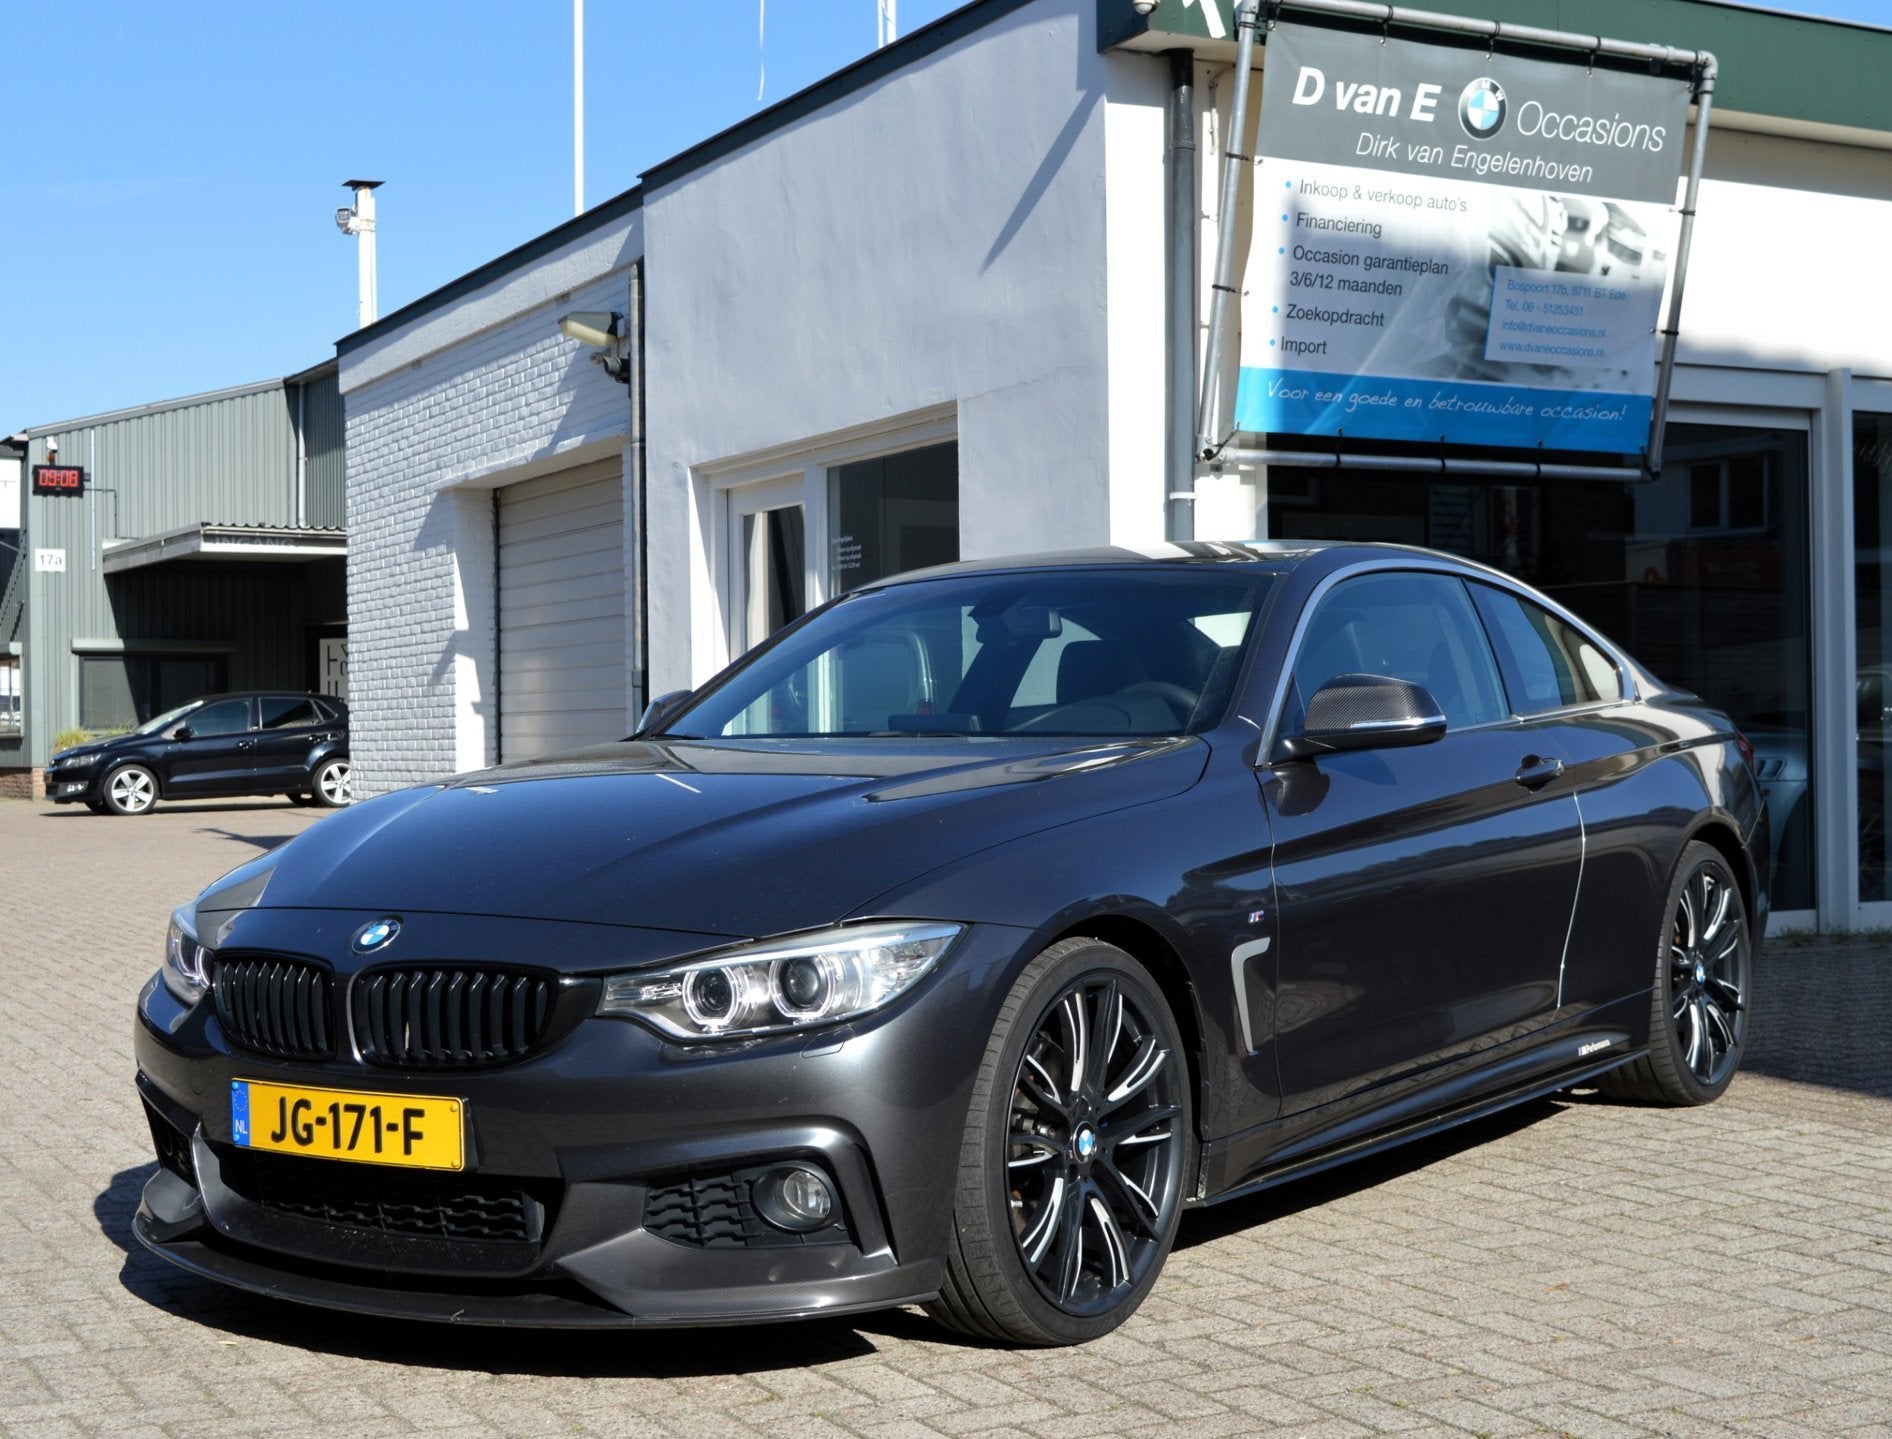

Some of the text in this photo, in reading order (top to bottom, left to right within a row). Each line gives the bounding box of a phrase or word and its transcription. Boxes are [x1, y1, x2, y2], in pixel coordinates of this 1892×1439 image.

[1292, 66, 1443, 122] D van E
[1517, 100, 1666, 152] Occasions
[1356, 132, 1593, 183] Dirk van Engelenhoven
[1299, 179, 1467, 212] Inkoop & verkoop auto's
[1296, 211, 1383, 239] Financiering
[1293, 245, 1449, 276] Occasion garantieplan
[1290, 270, 1403, 296] 3/6/12 maanden
[1507, 279, 1550, 293] Bospoort
[1594, 287, 1608, 299] BT
[1609, 288, 1627, 301] Ede
[1286, 303, 1385, 327] Zoekopdracht
[1505, 299, 1518, 311] Tel.
[1522, 300, 1535, 312] 06
[1280, 336, 1328, 356] Import
[1499, 341, 1605, 358] www.dvaneoccasions.nl
[1267, 378, 1627, 420] Voor een goede en betrouwbare occasion!
[38, 468, 79, 487] 09:08
[40, 554, 63, 566] 17a
[235, 1119, 248, 1135] NL
[270, 1096, 425, 1156] JG-171-F
